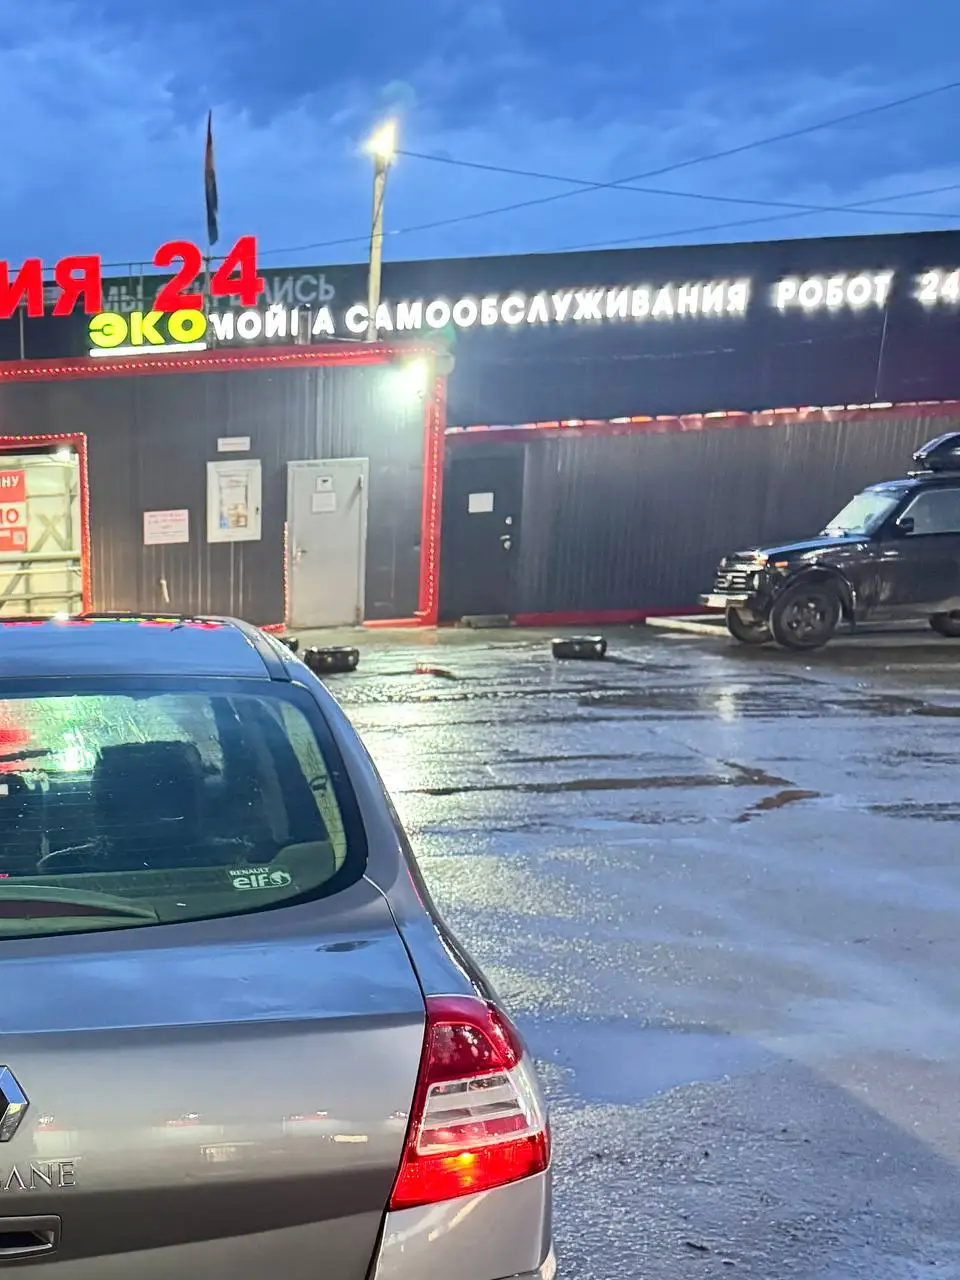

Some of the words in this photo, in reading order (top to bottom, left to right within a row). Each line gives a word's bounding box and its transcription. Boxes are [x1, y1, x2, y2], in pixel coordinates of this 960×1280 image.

[152, 236, 265, 312] 24
[344, 282, 748, 334] САМООБСЛУЖИВАНИЯ
[776, 272, 892, 310] РОБОТ
[918, 271, 960, 303] 24
[229, 867, 269, 876] RENAULT
[232, 874, 268, 888] elf
